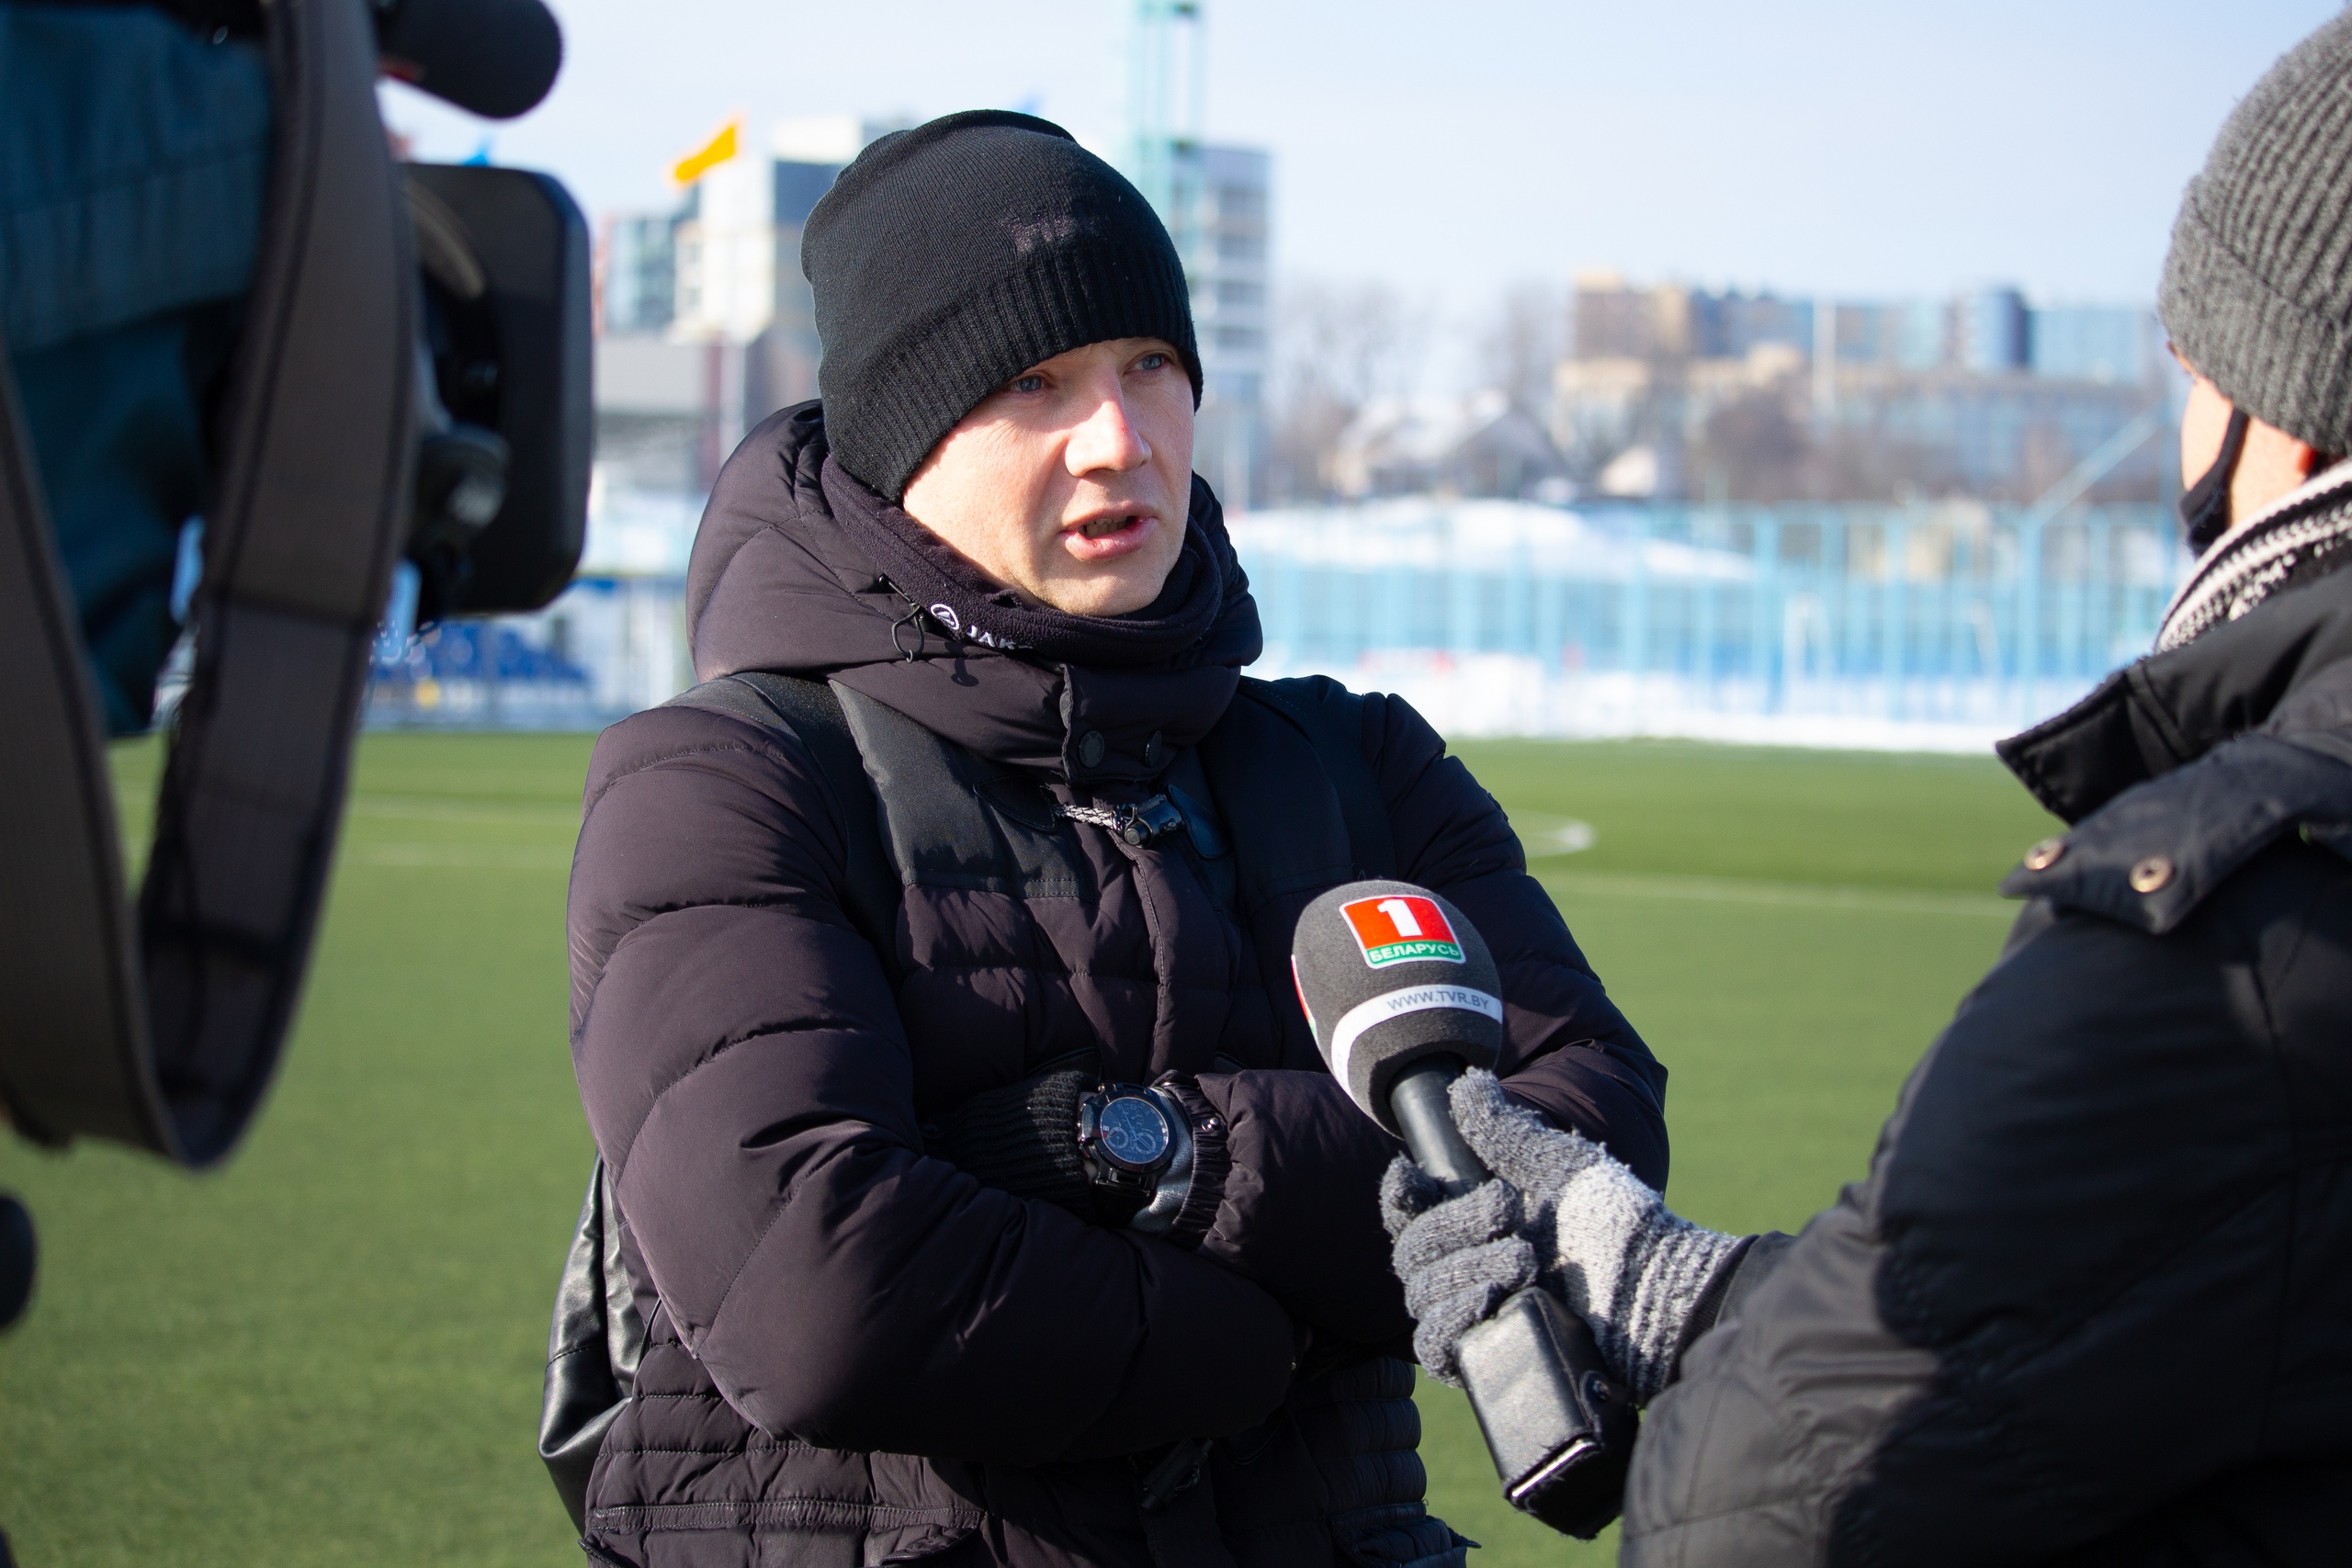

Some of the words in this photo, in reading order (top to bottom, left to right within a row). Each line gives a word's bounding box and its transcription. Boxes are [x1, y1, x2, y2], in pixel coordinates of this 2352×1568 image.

[967, 626, 1033, 649] JAK
[1377, 898, 1423, 937] 1
[1369, 943, 1459, 963] БЕЛАРУСЬ
[1387, 991, 1488, 1011] WWW.TVR.BY
